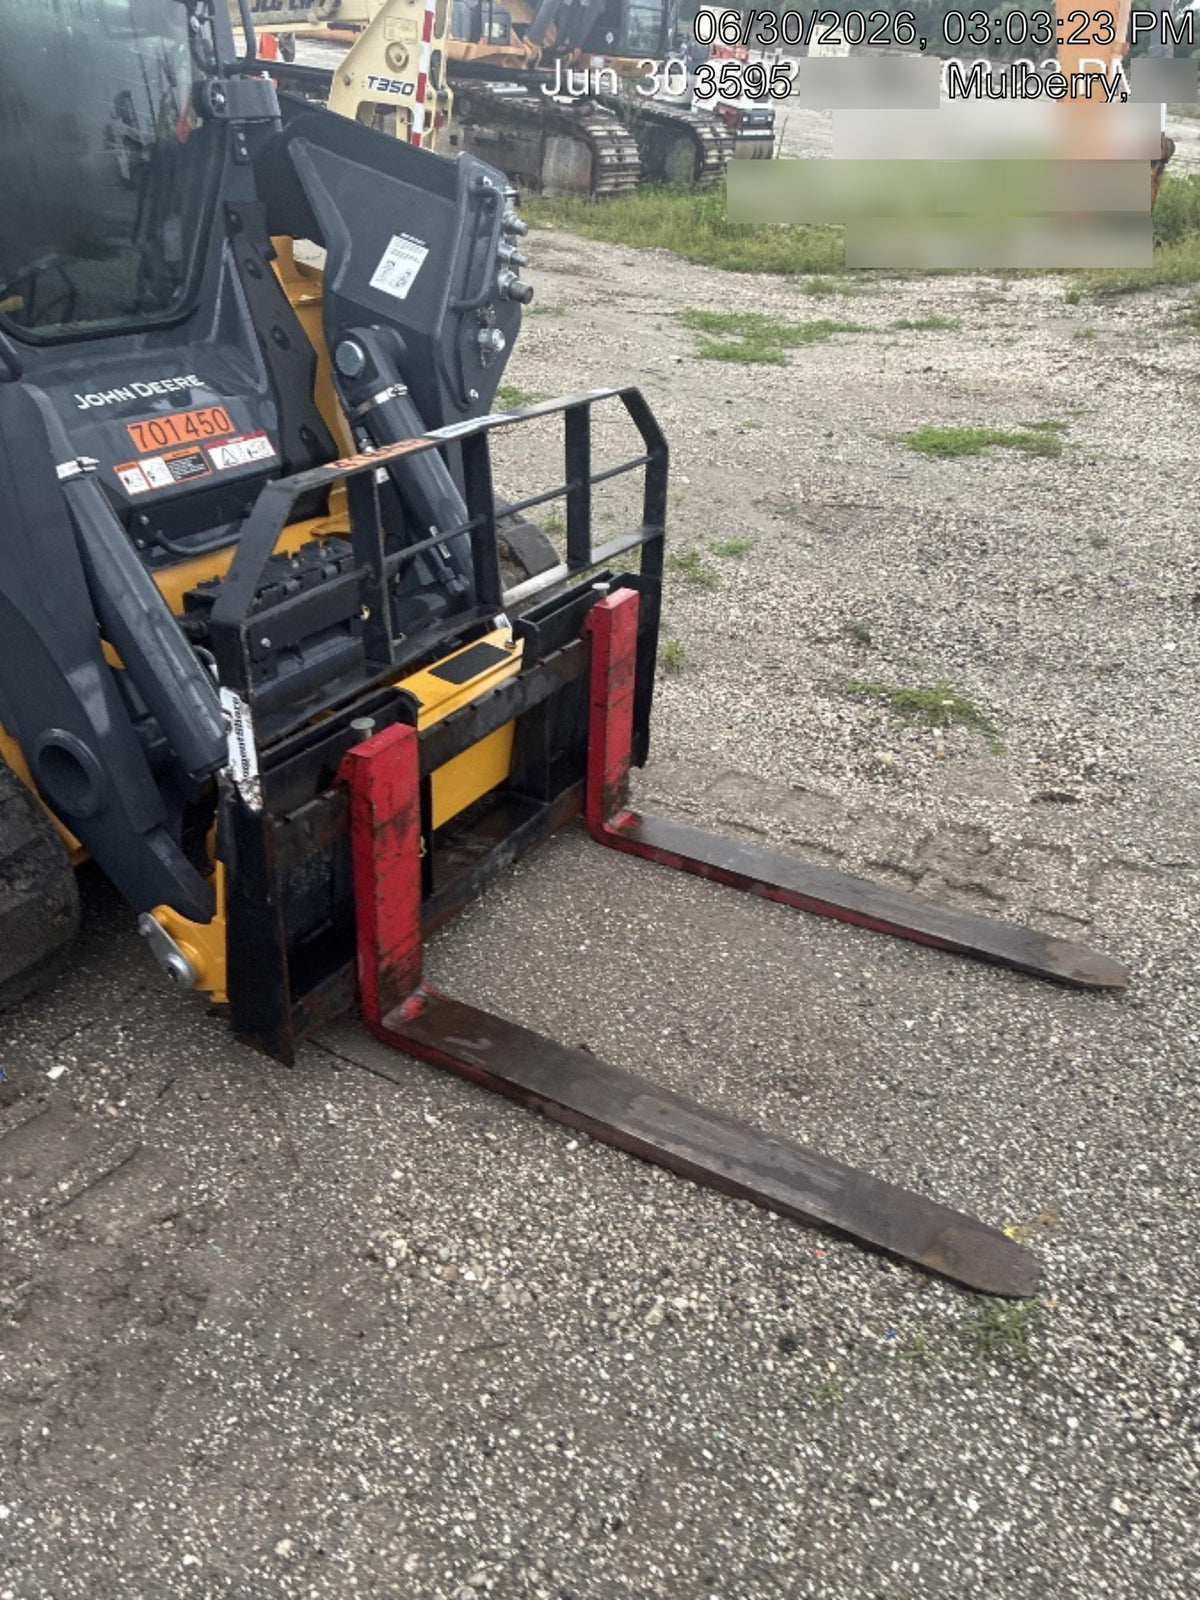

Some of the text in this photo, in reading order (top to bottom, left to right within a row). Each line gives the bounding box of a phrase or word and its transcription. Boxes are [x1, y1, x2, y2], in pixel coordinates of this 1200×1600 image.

[367, 75, 416, 97] T350
[74, 374, 205, 410] JOHN DEERE
[129, 408, 231, 449] 701450
